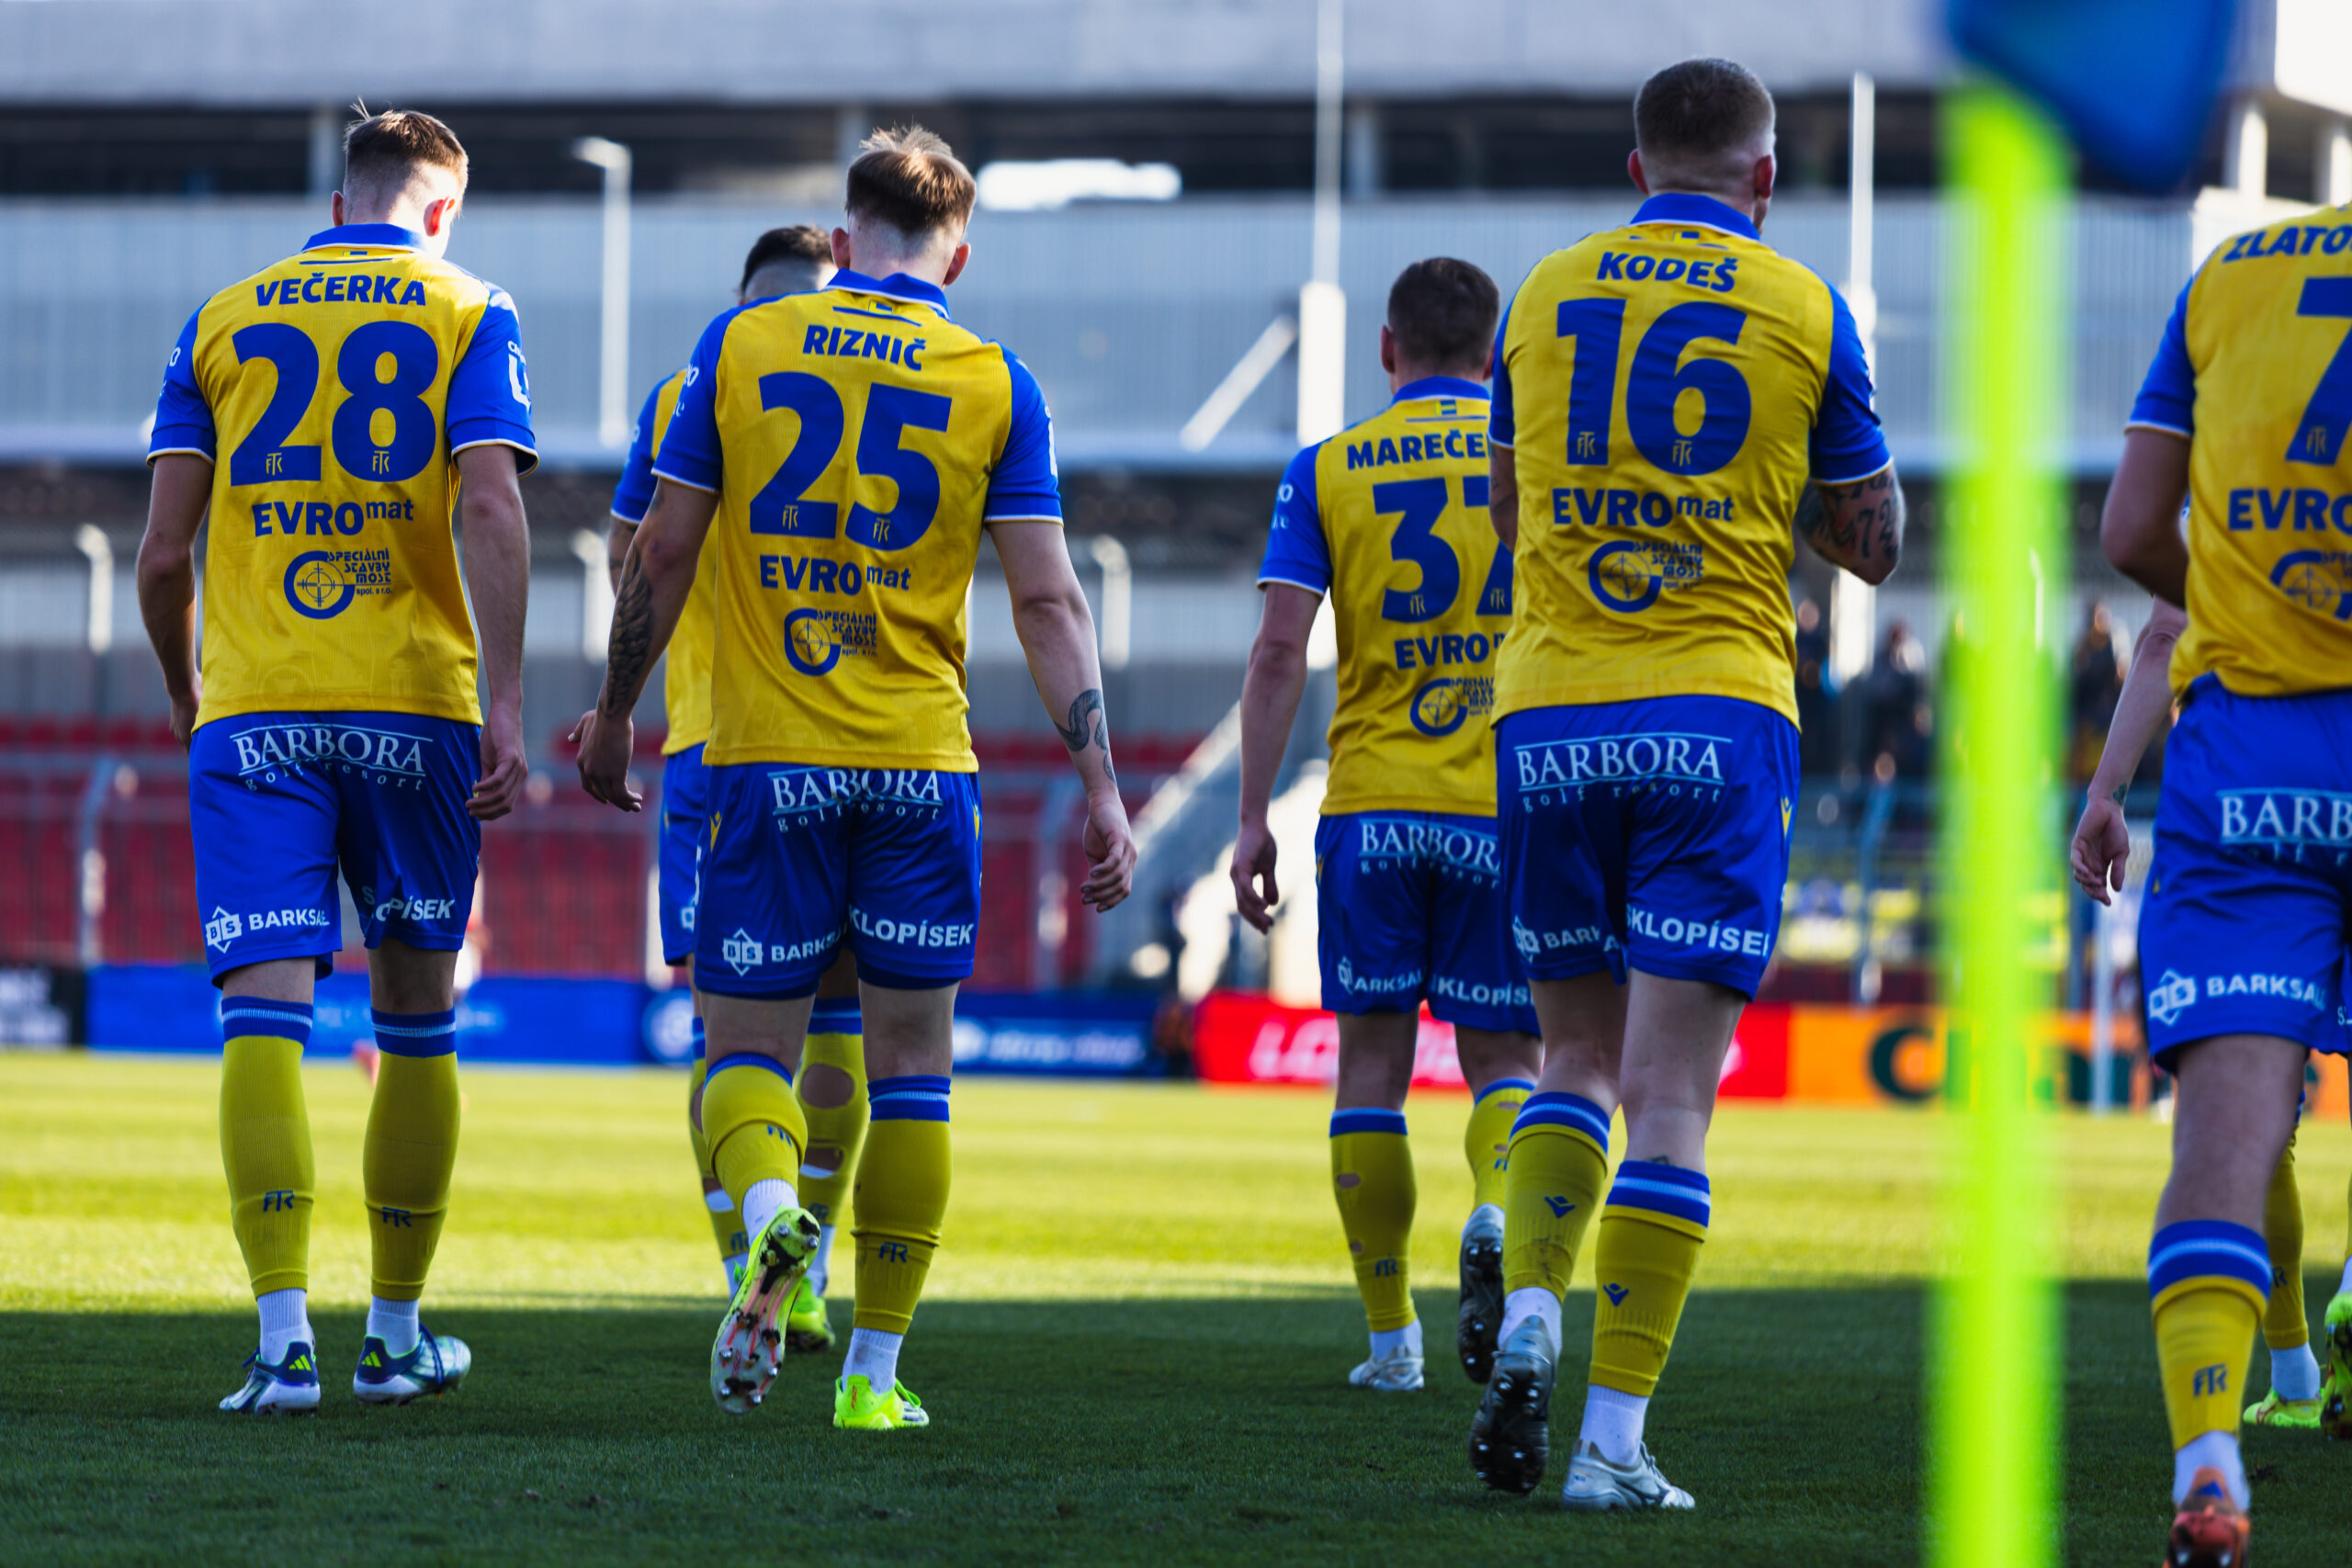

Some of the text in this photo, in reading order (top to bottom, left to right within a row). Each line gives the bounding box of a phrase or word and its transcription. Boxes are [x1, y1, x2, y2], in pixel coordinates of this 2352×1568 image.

[2222, 223, 2352, 264] ZLATO
[255, 272, 427, 307] VEČERKA
[1596, 252, 1738, 293] KODEŠ
[802, 324, 926, 371] RIZNIČ
[231, 321, 439, 487] 28
[1556, 297, 1751, 476] 16
[750, 371, 953, 551] 25
[1347, 429, 1492, 471] MAREČE
[345, 561, 390, 573] STAVBY
[356, 572, 391, 583] MOST
[233, 728, 425, 773] BARBORA
[1517, 737, 1724, 787] BARBORA
[1522, 785, 1587, 814] golf
[1362, 822, 1501, 873] BARBOR
